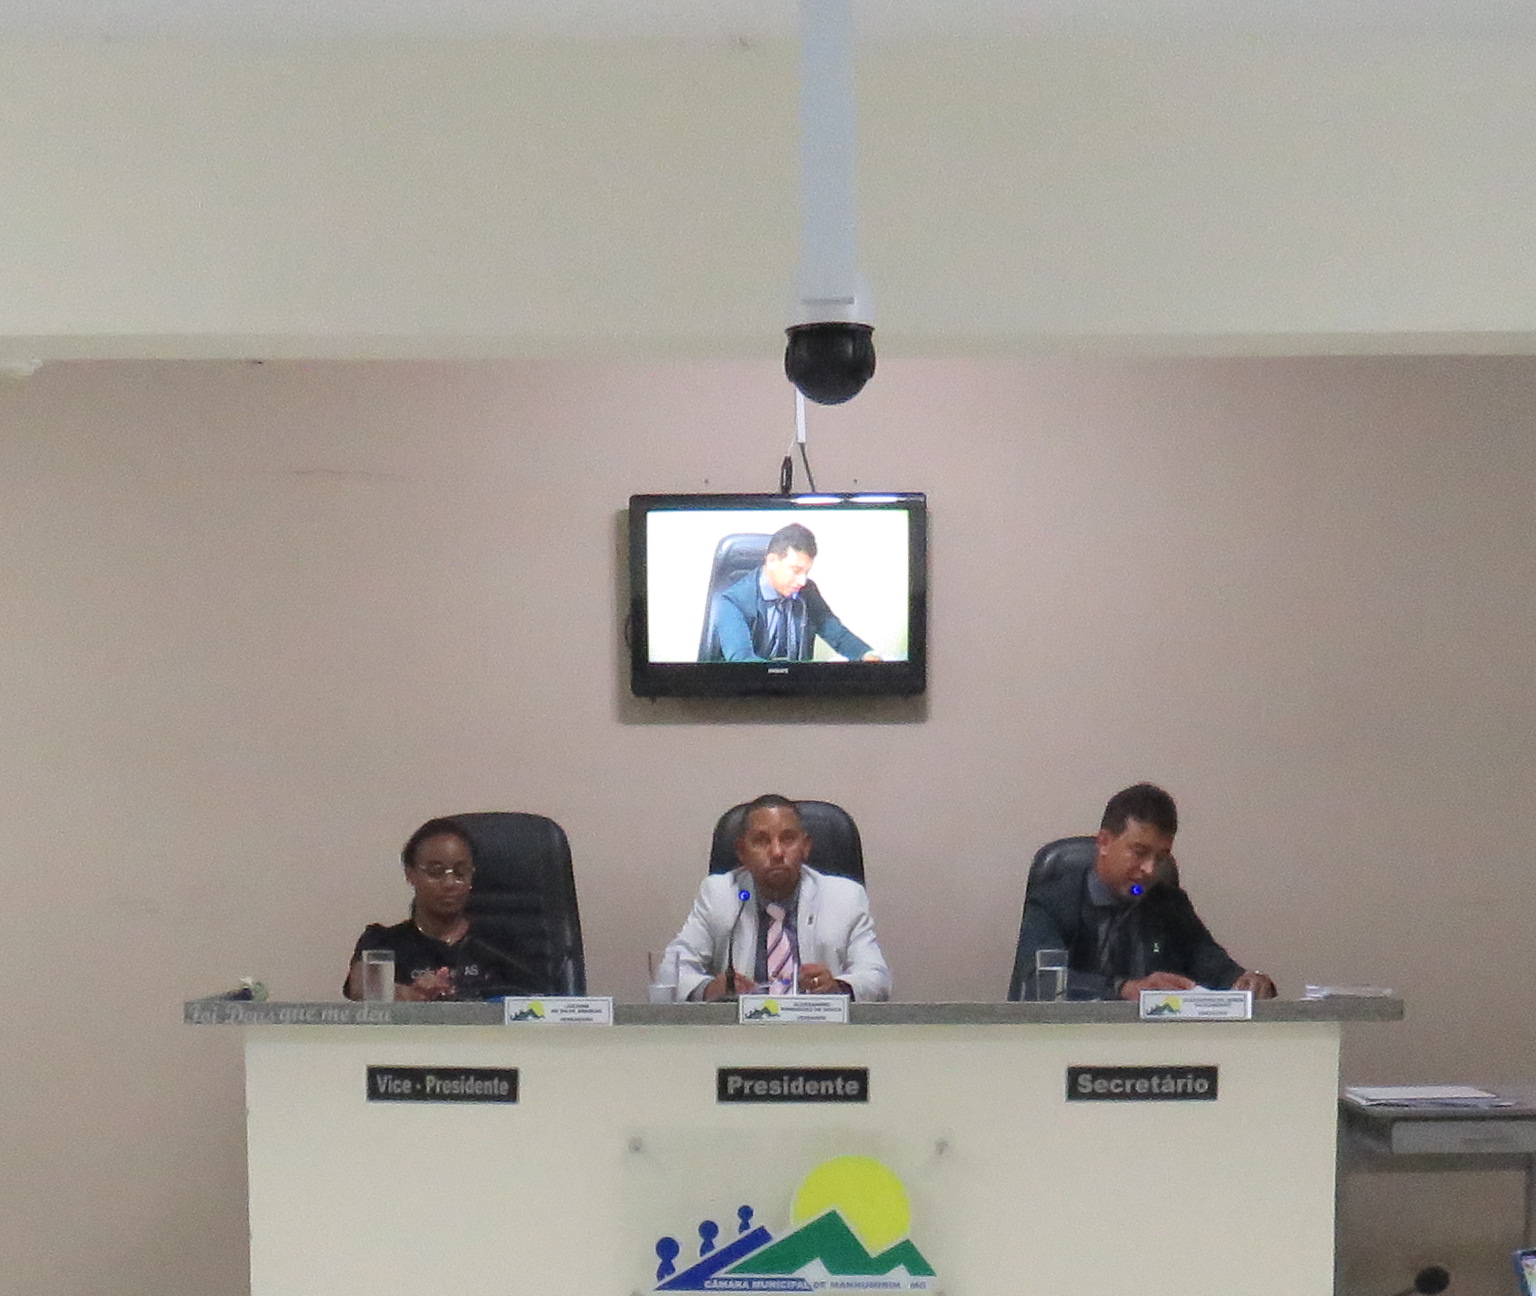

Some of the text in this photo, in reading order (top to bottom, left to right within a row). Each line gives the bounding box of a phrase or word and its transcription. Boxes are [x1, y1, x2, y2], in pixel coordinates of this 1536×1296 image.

[225, 1003, 275, 1023] Deus
[279, 1004, 315, 1024] que
[322, 1006, 349, 1021] me
[356, 1002, 391, 1021] deu
[376, 1074, 412, 1094] Vice
[426, 1075, 510, 1096] Presidente
[727, 1075, 860, 1096] Presidente
[1077, 1073, 1210, 1094] Secretário
[752, 1280, 810, 1290] MUNICIPAL
